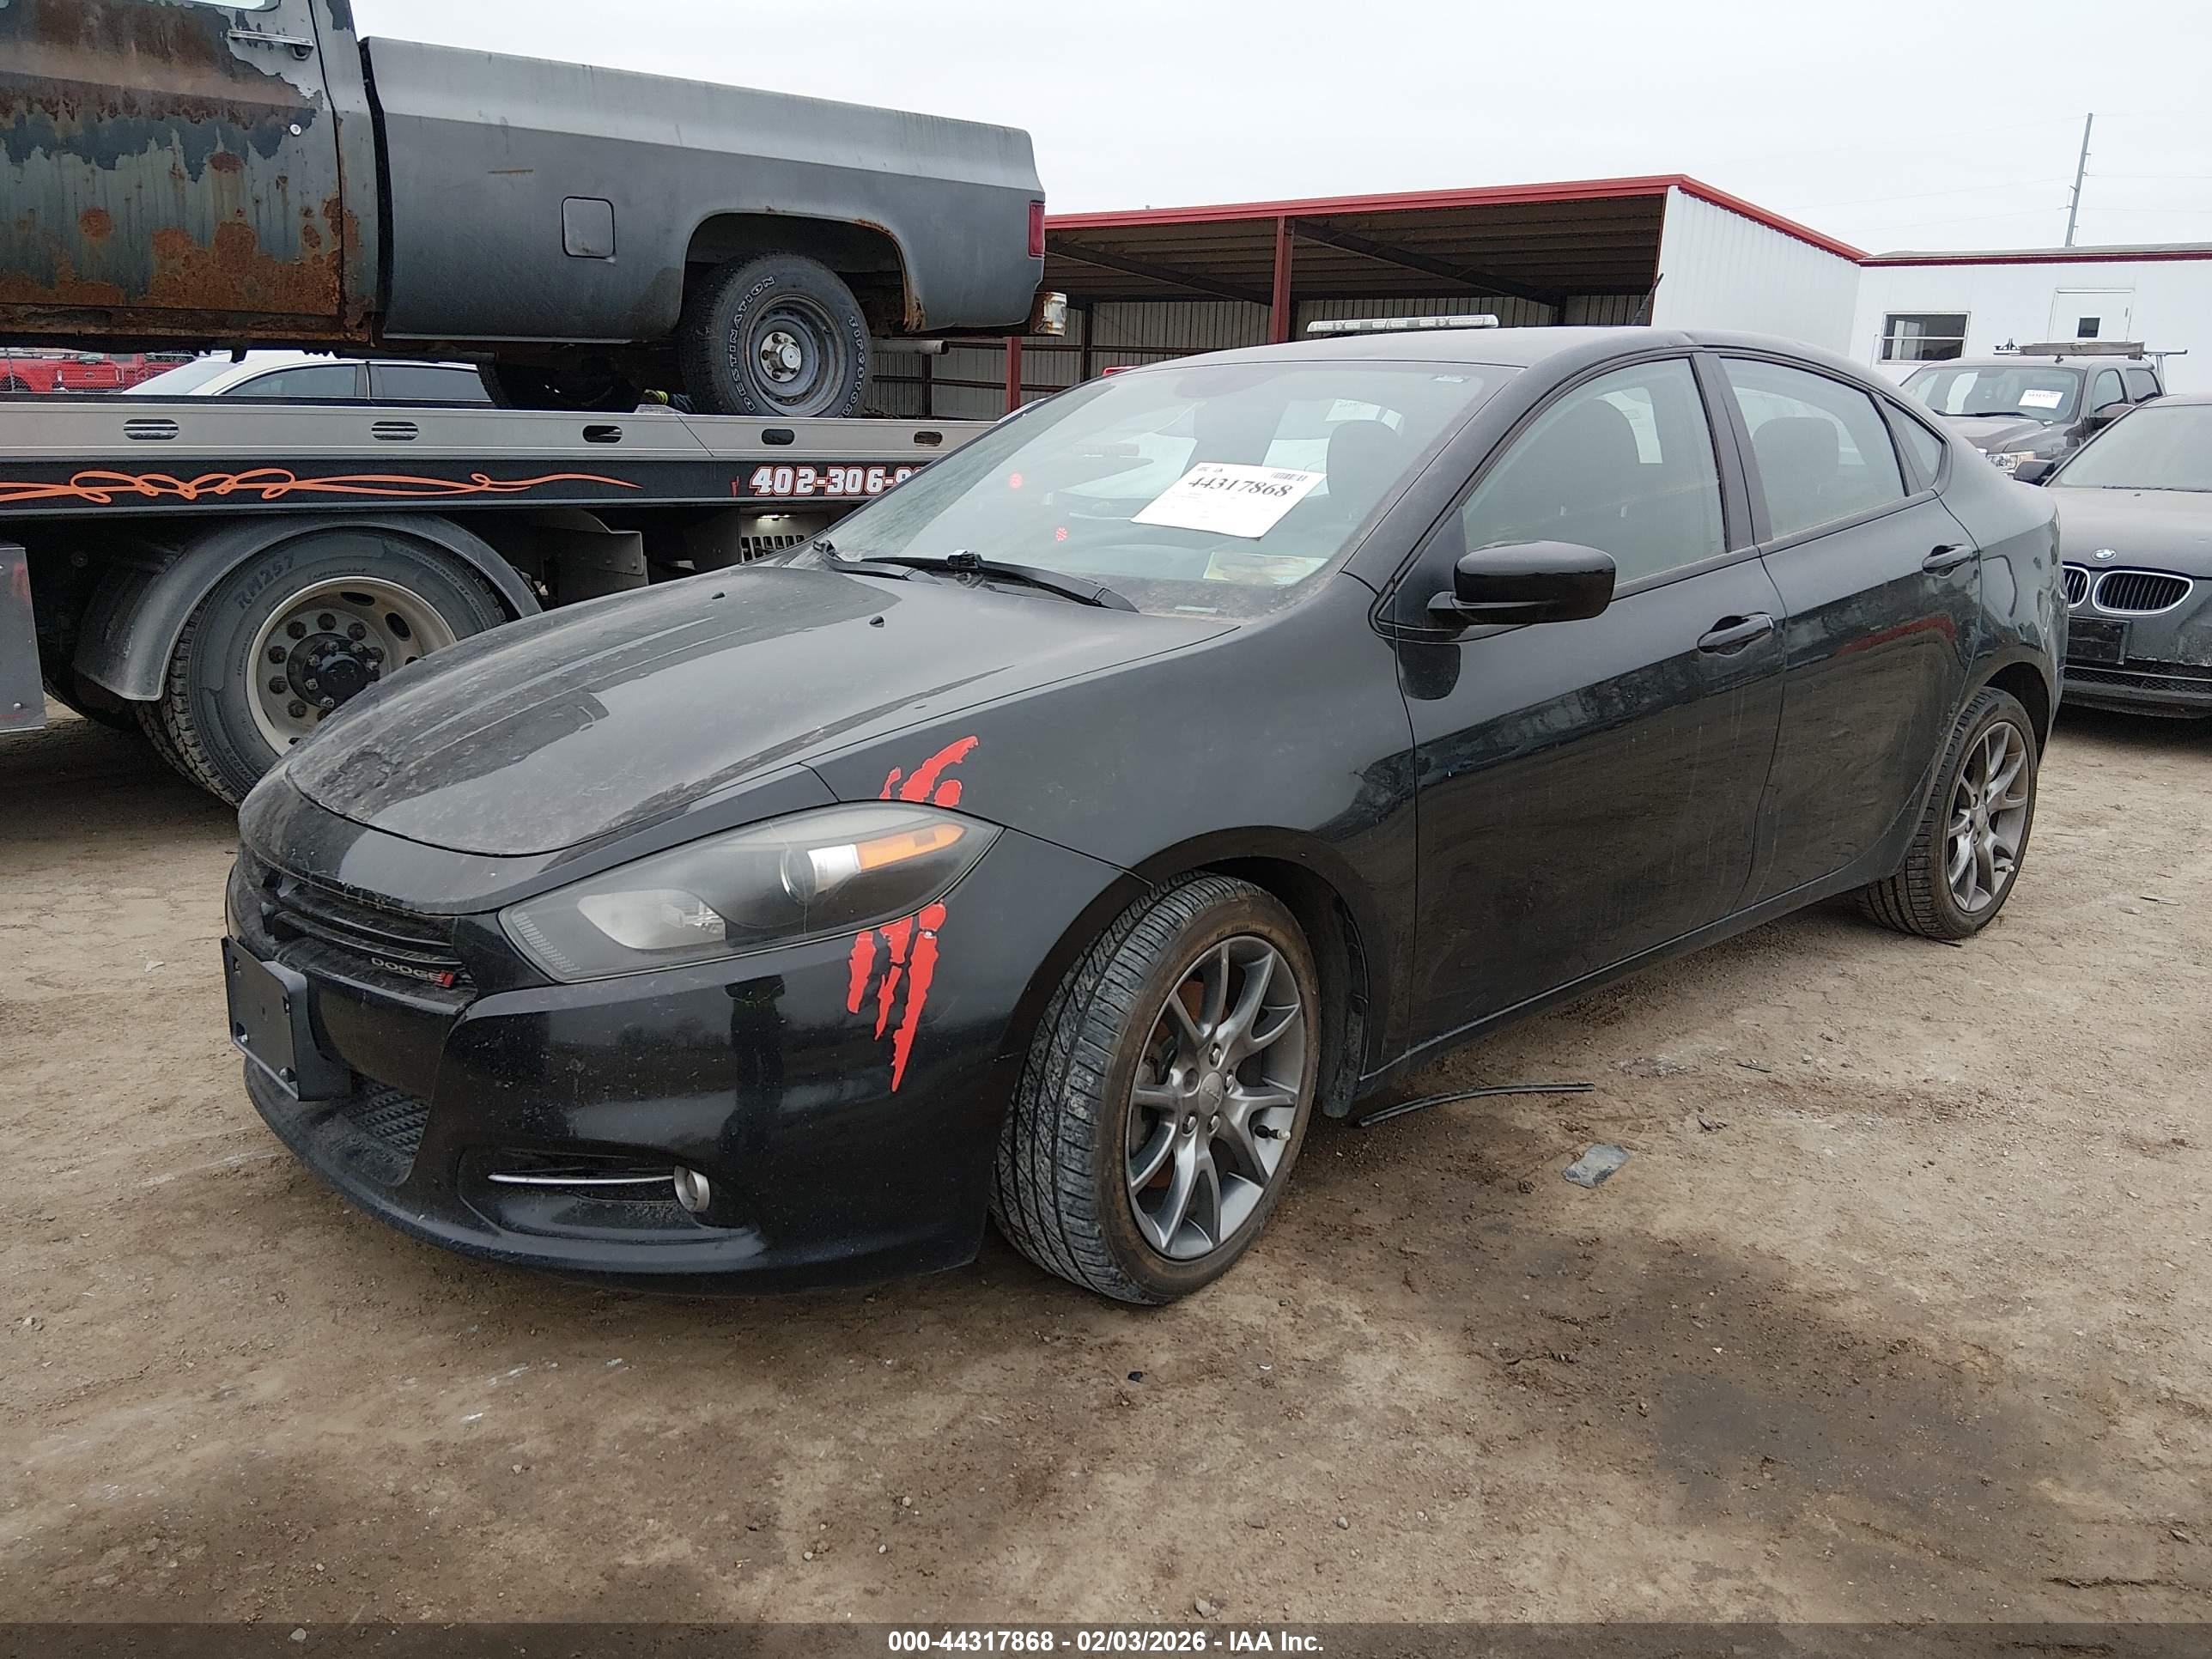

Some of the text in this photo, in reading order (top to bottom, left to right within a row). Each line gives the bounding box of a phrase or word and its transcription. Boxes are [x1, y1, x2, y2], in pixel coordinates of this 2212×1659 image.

[730, 276, 775, 411] DESTINATION
[1188, 476, 1294, 498] 44317868
[370, 957, 444, 983] DODGE
